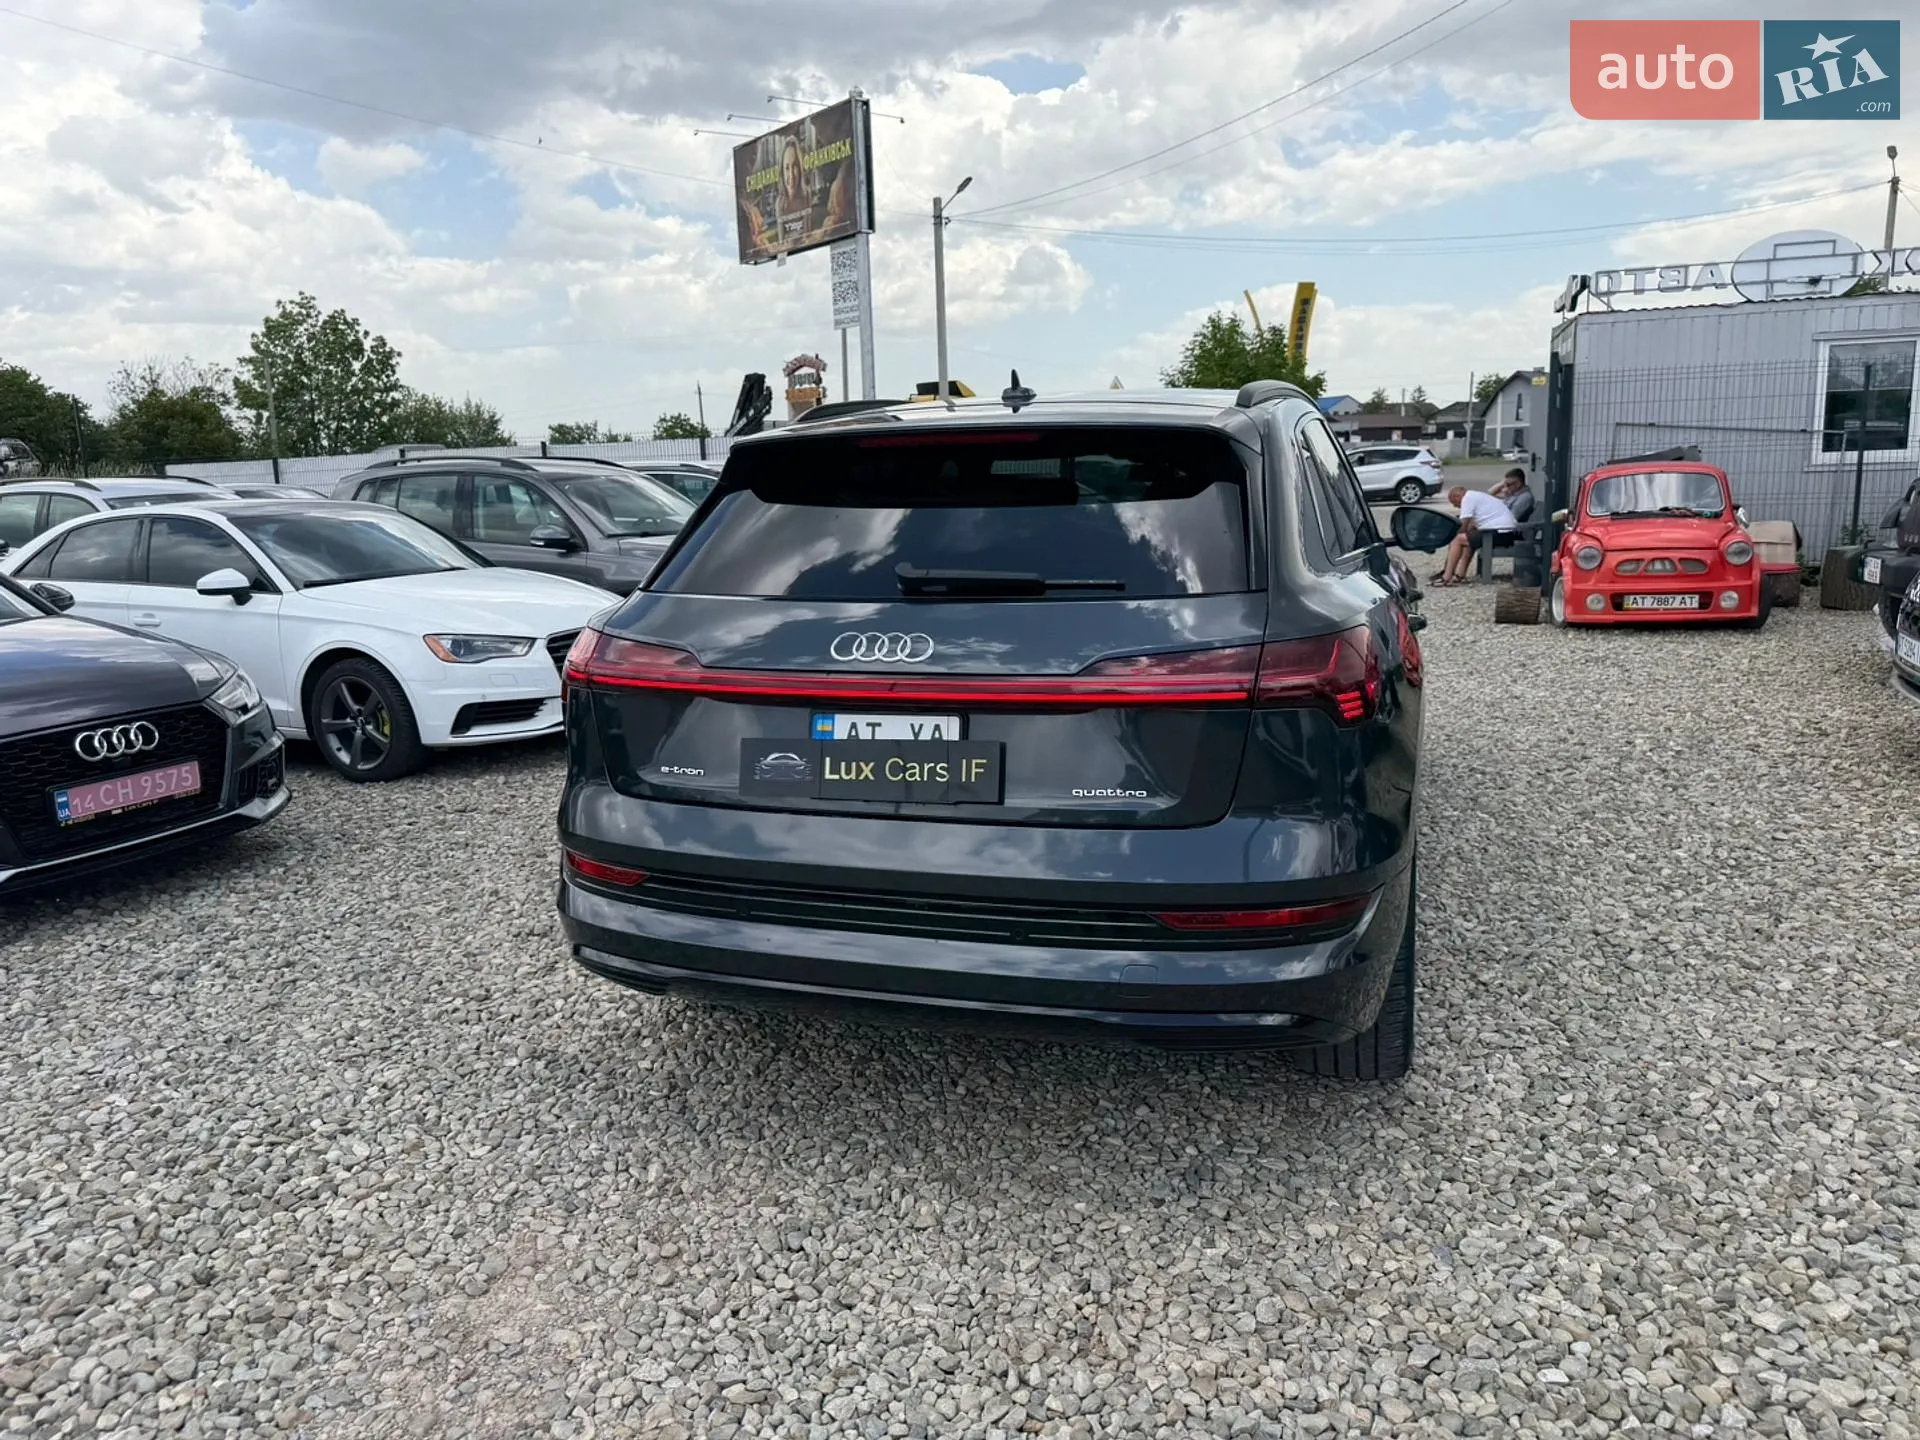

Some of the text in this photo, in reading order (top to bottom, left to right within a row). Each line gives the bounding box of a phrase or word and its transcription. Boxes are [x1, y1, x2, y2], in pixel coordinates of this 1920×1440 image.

[1631, 595, 1696, 607] AT 7887 AT
[847, 721, 882, 741] AT
[661, 766, 705, 776] e-tron
[824, 756, 987, 782] Lux Cars IF
[73, 793, 95, 813] 14
[100, 779, 133, 805] CH
[140, 766, 192, 797] 9575
[1072, 788, 1147, 798] quattro
[57, 808, 71, 818] UA
